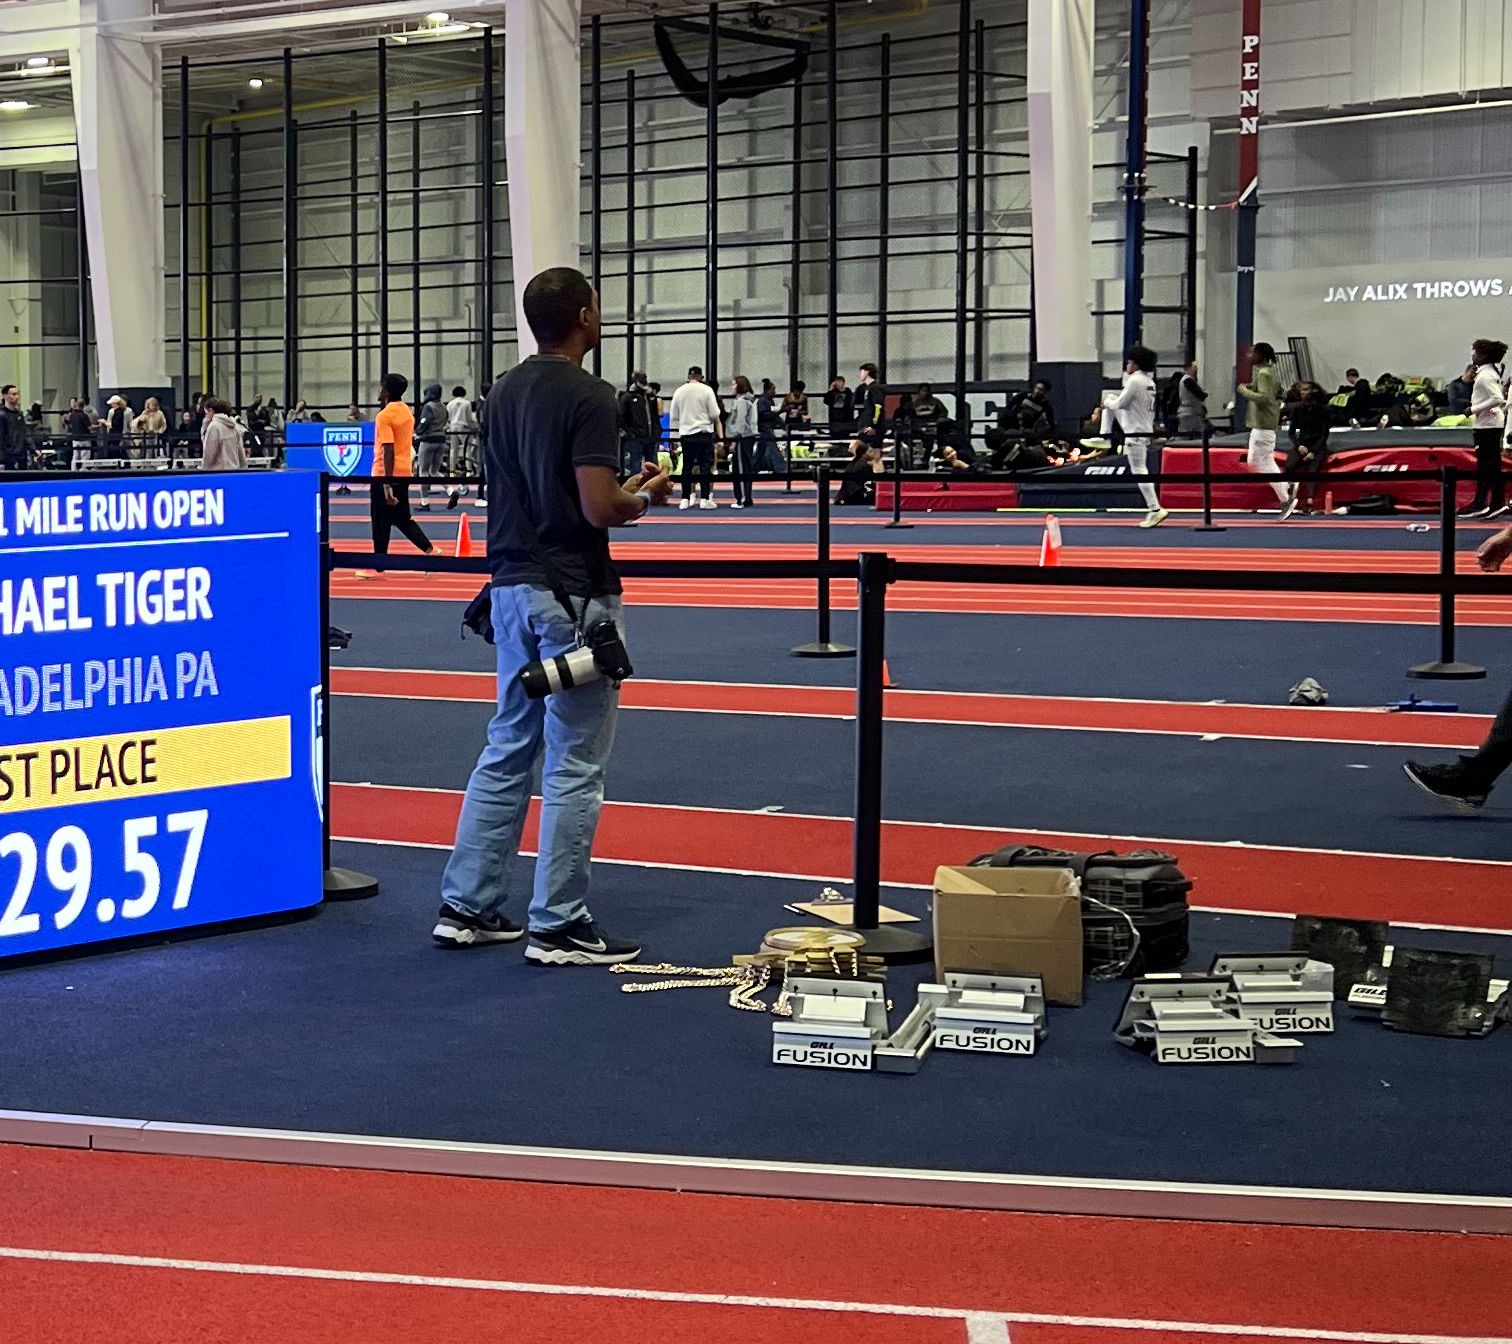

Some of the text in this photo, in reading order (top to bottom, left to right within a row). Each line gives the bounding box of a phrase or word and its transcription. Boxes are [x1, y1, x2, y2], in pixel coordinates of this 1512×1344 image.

[1240, 35, 1260, 135] PENN
[1324, 286, 1360, 303] JAY
[1362, 283, 1408, 302] ALIX
[1413, 278, 1504, 300] THROWS
[328, 433, 358, 442] PENN
[15, 495, 84, 536] MILE
[89, 492, 148, 532] RUN
[152, 488, 224, 529] OPEN
[96, 566, 214, 627] TIGER
[175, 650, 220, 699] PA
[50, 738, 158, 796] PLACE
[776, 1048, 869, 1067] FUSION
[939, 1033, 1032, 1052] FUSION
[1161, 1045, 1252, 1061] FUSION
